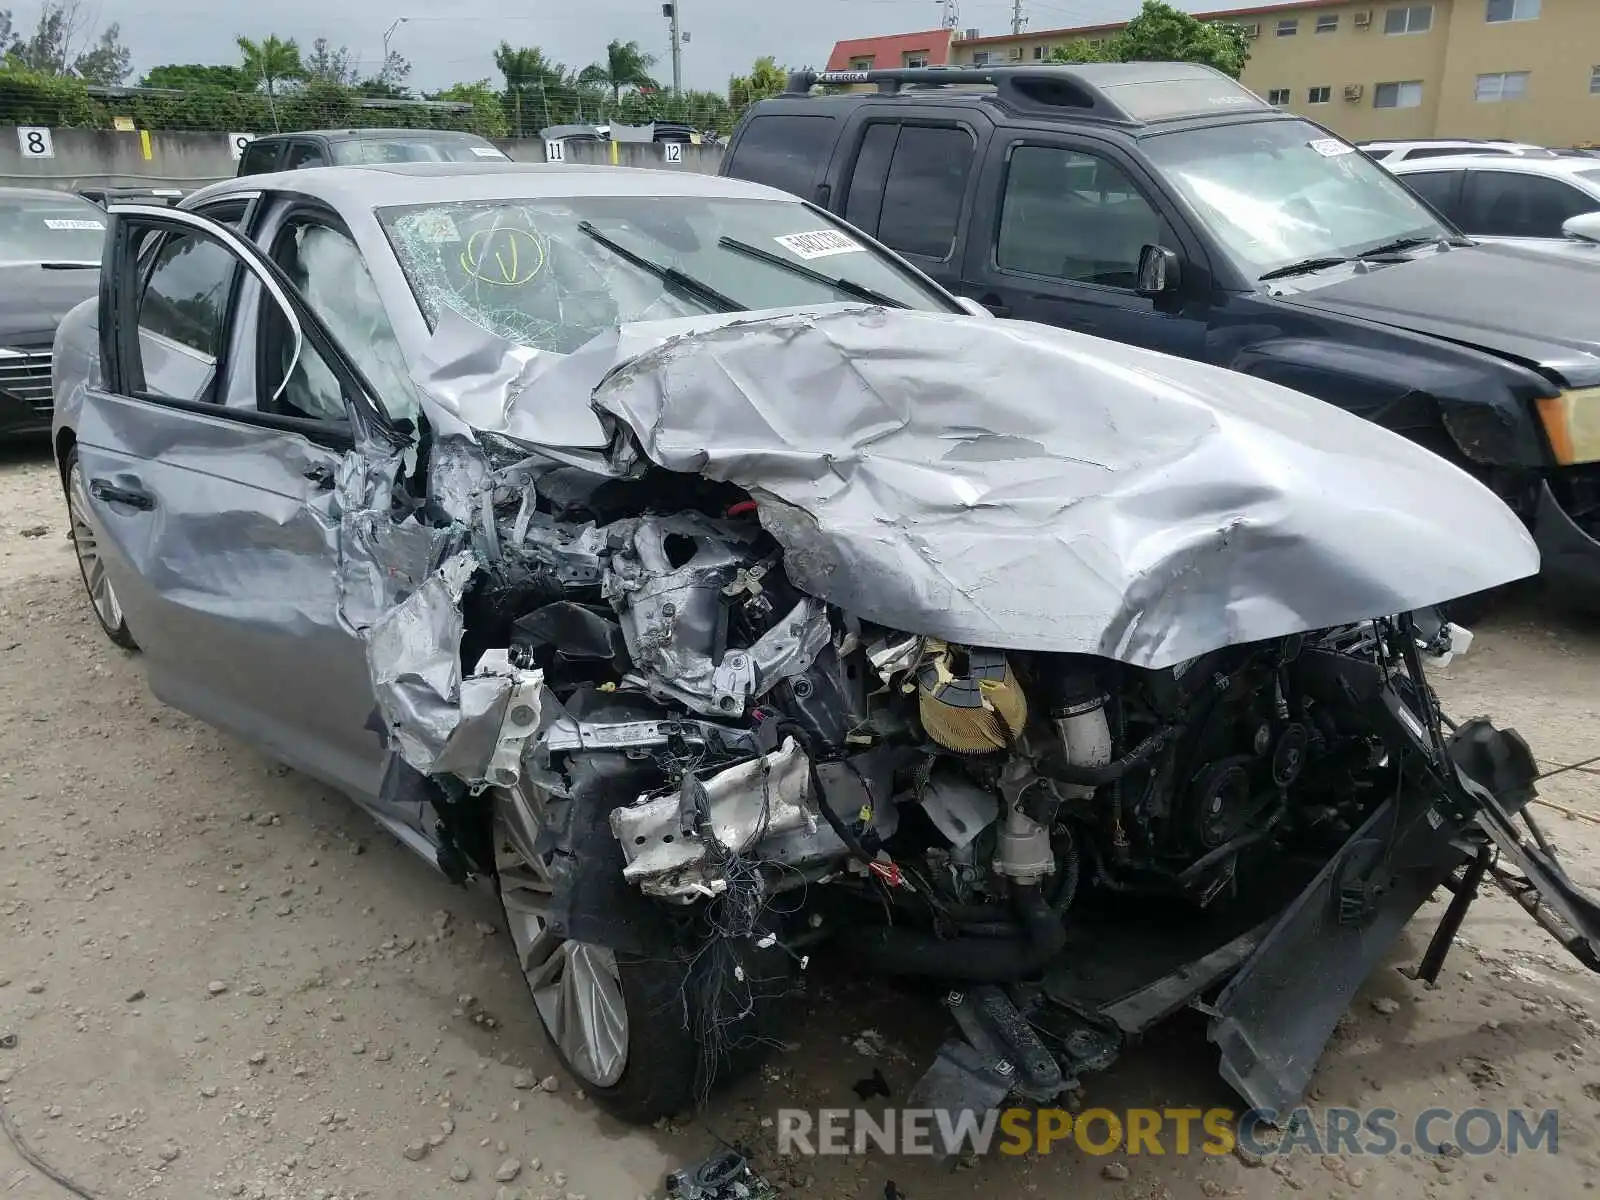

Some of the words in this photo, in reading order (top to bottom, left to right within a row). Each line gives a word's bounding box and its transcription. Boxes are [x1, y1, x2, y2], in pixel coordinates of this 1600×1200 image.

[815, 71, 868, 82] XTERRA
[27, 131, 45, 154] 8
[549, 143, 562, 160] 11
[666, 145, 680, 161] 12
